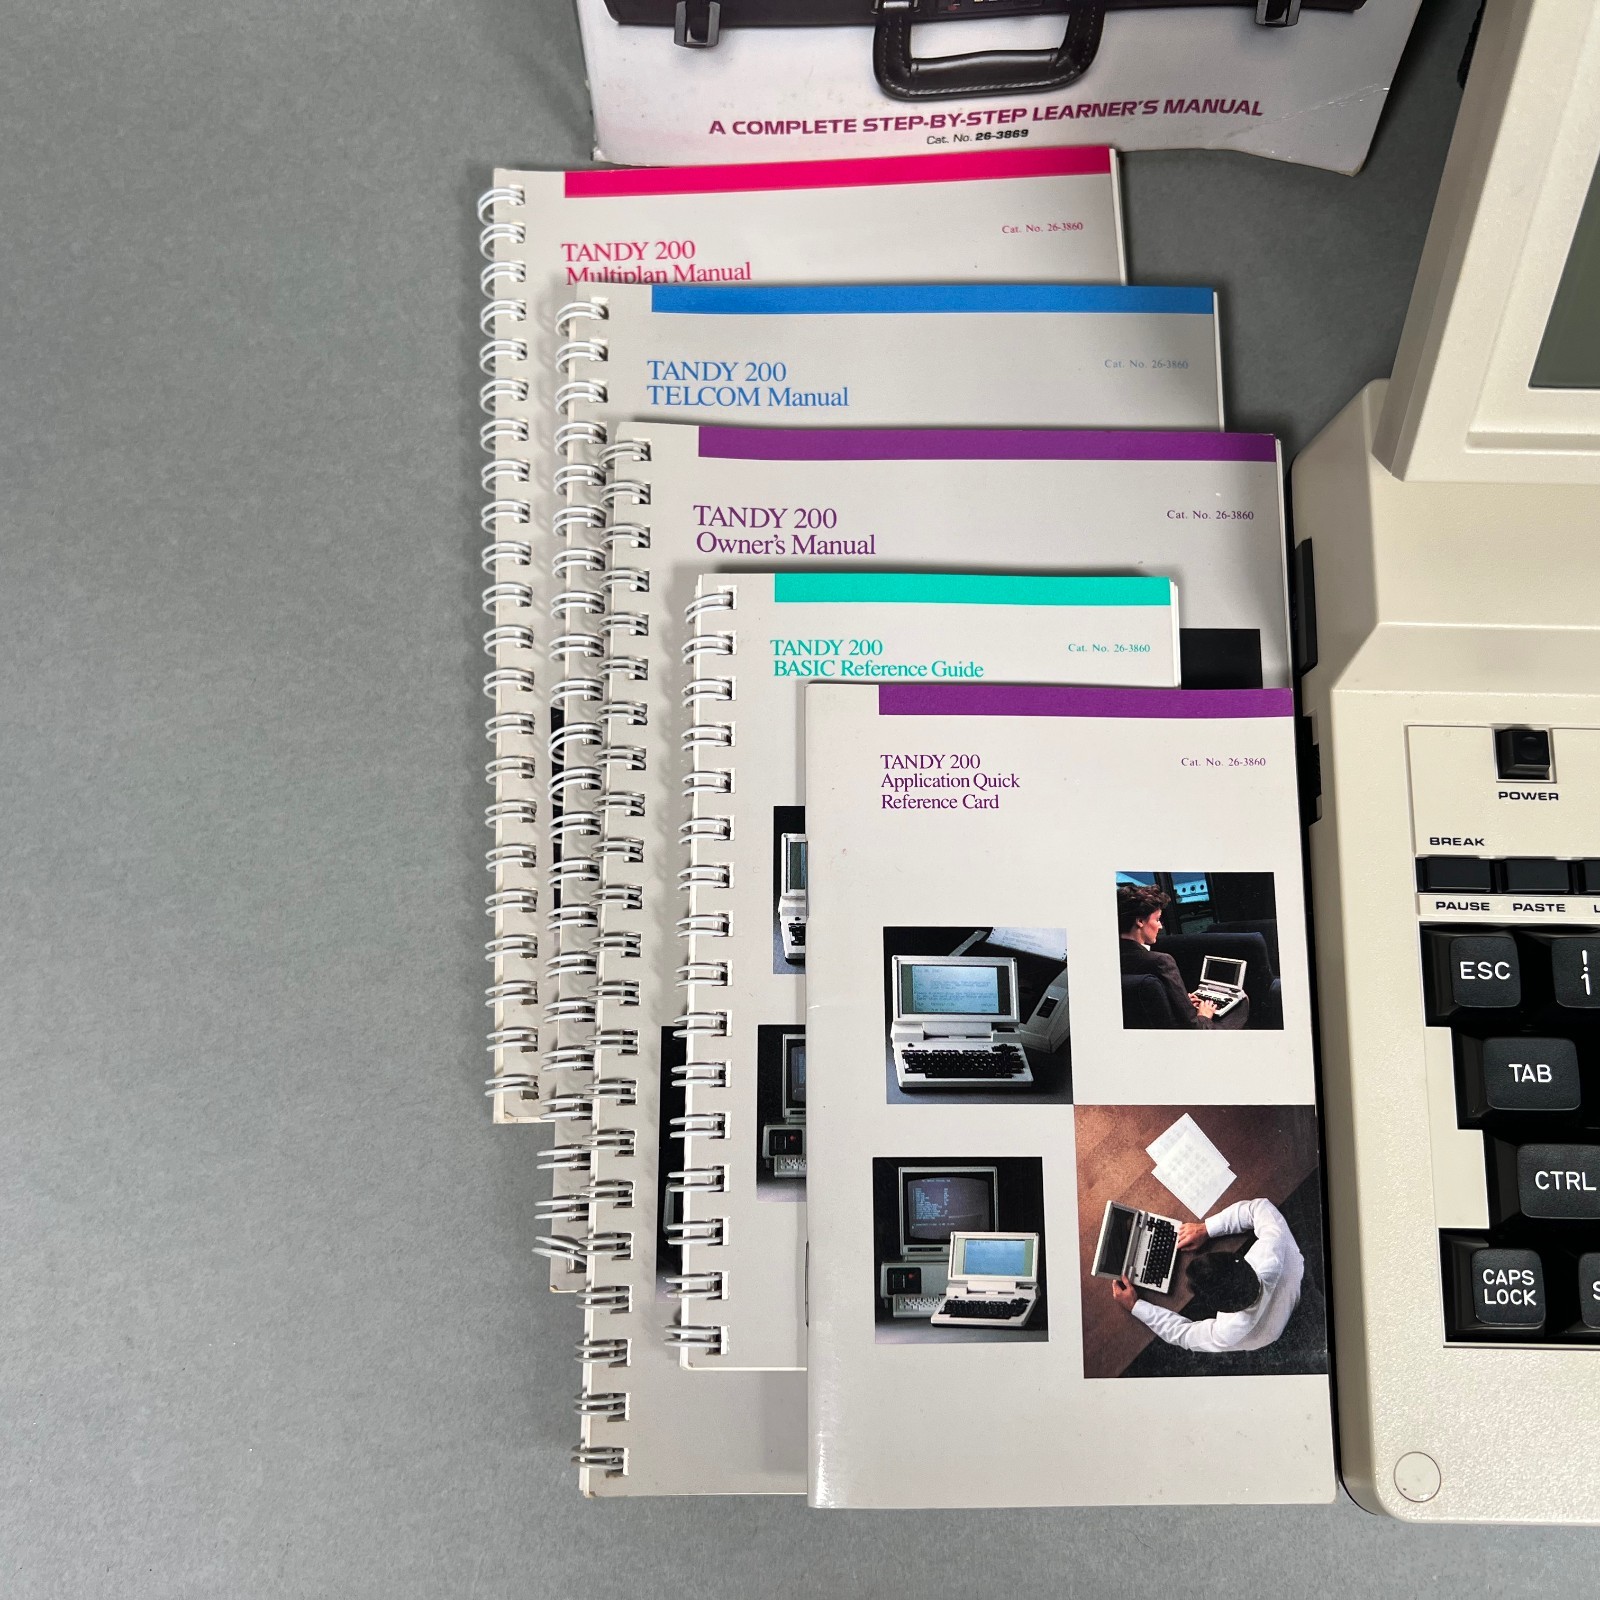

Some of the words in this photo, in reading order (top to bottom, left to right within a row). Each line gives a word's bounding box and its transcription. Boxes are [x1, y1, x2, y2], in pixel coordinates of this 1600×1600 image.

[709, 120, 726, 135] A
[732, 118, 857, 135] COMPLETE
[862, 109, 1027, 132] STEP-BY-STEP
[1032, 100, 1159, 121] LEARNER'S
[1163, 98, 1264, 117] MANUAL
[926, 135, 949, 145] Cat.
[953, 133, 972, 143] No.
[975, 129, 1029, 141] 26-3869
[1001, 225, 1021, 234] Cat.
[1025, 224, 1043, 233] No.
[1047, 222, 1084, 232] 26-3860
[561, 241, 649, 262] TANDY
[655, 240, 696, 260] 200
[566, 265, 668, 285] Multiplan
[673, 262, 752, 283] Manual
[647, 360, 739, 382] TANDY
[744, 362, 787, 382] 200
[1104, 359, 1125, 369] Cat.
[1129, 359, 1147, 369] No.
[1151, 359, 1189, 370] 26-3860
[647, 385, 760, 407] TELCOM
[767, 387, 850, 407] Manual
[693, 505, 788, 529] TANDY
[793, 508, 838, 529] 200
[1166, 509, 1188, 519] Cat.
[1192, 510, 1211, 520] No.
[1215, 510, 1255, 521] 26-3860
[696, 532, 786, 555] Owner's
[791, 534, 876, 556] Manual
[770, 639, 844, 656] TANDY
[848, 639, 884, 656] 200
[1068, 643, 1087, 652] Cat.
[1092, 643, 1109, 652] No.
[1113, 643, 1151, 653] 26-3860
[773, 660, 835, 677] BASIC
[841, 660, 928, 678] Reference
[931, 661, 985, 678] Guide
[880, 754, 946, 770] TANDY
[949, 754, 981, 770] 200
[1181, 757, 1201, 767] Cat.
[1205, 757, 1224, 767] No.
[1228, 757, 1267, 767] 26-3860
[881, 772, 971, 793] Application
[973, 772, 1021, 792] Quick
[881, 794, 959, 809] Reference
[962, 794, 1000, 810] Card
[1498, 791, 1560, 801] POWER
[1429, 836, 1486, 847] BREAK
[1435, 901, 1491, 912] PAUSE
[1512, 903, 1567, 913] PASTE
[1459, 961, 1511, 981] ESC
[1508, 1064, 1552, 1083] TAB
[1534, 1170, 1597, 1191] CTRL
[1482, 1268, 1535, 1286] CAPS
[1483, 1288, 1537, 1306] LOCK
